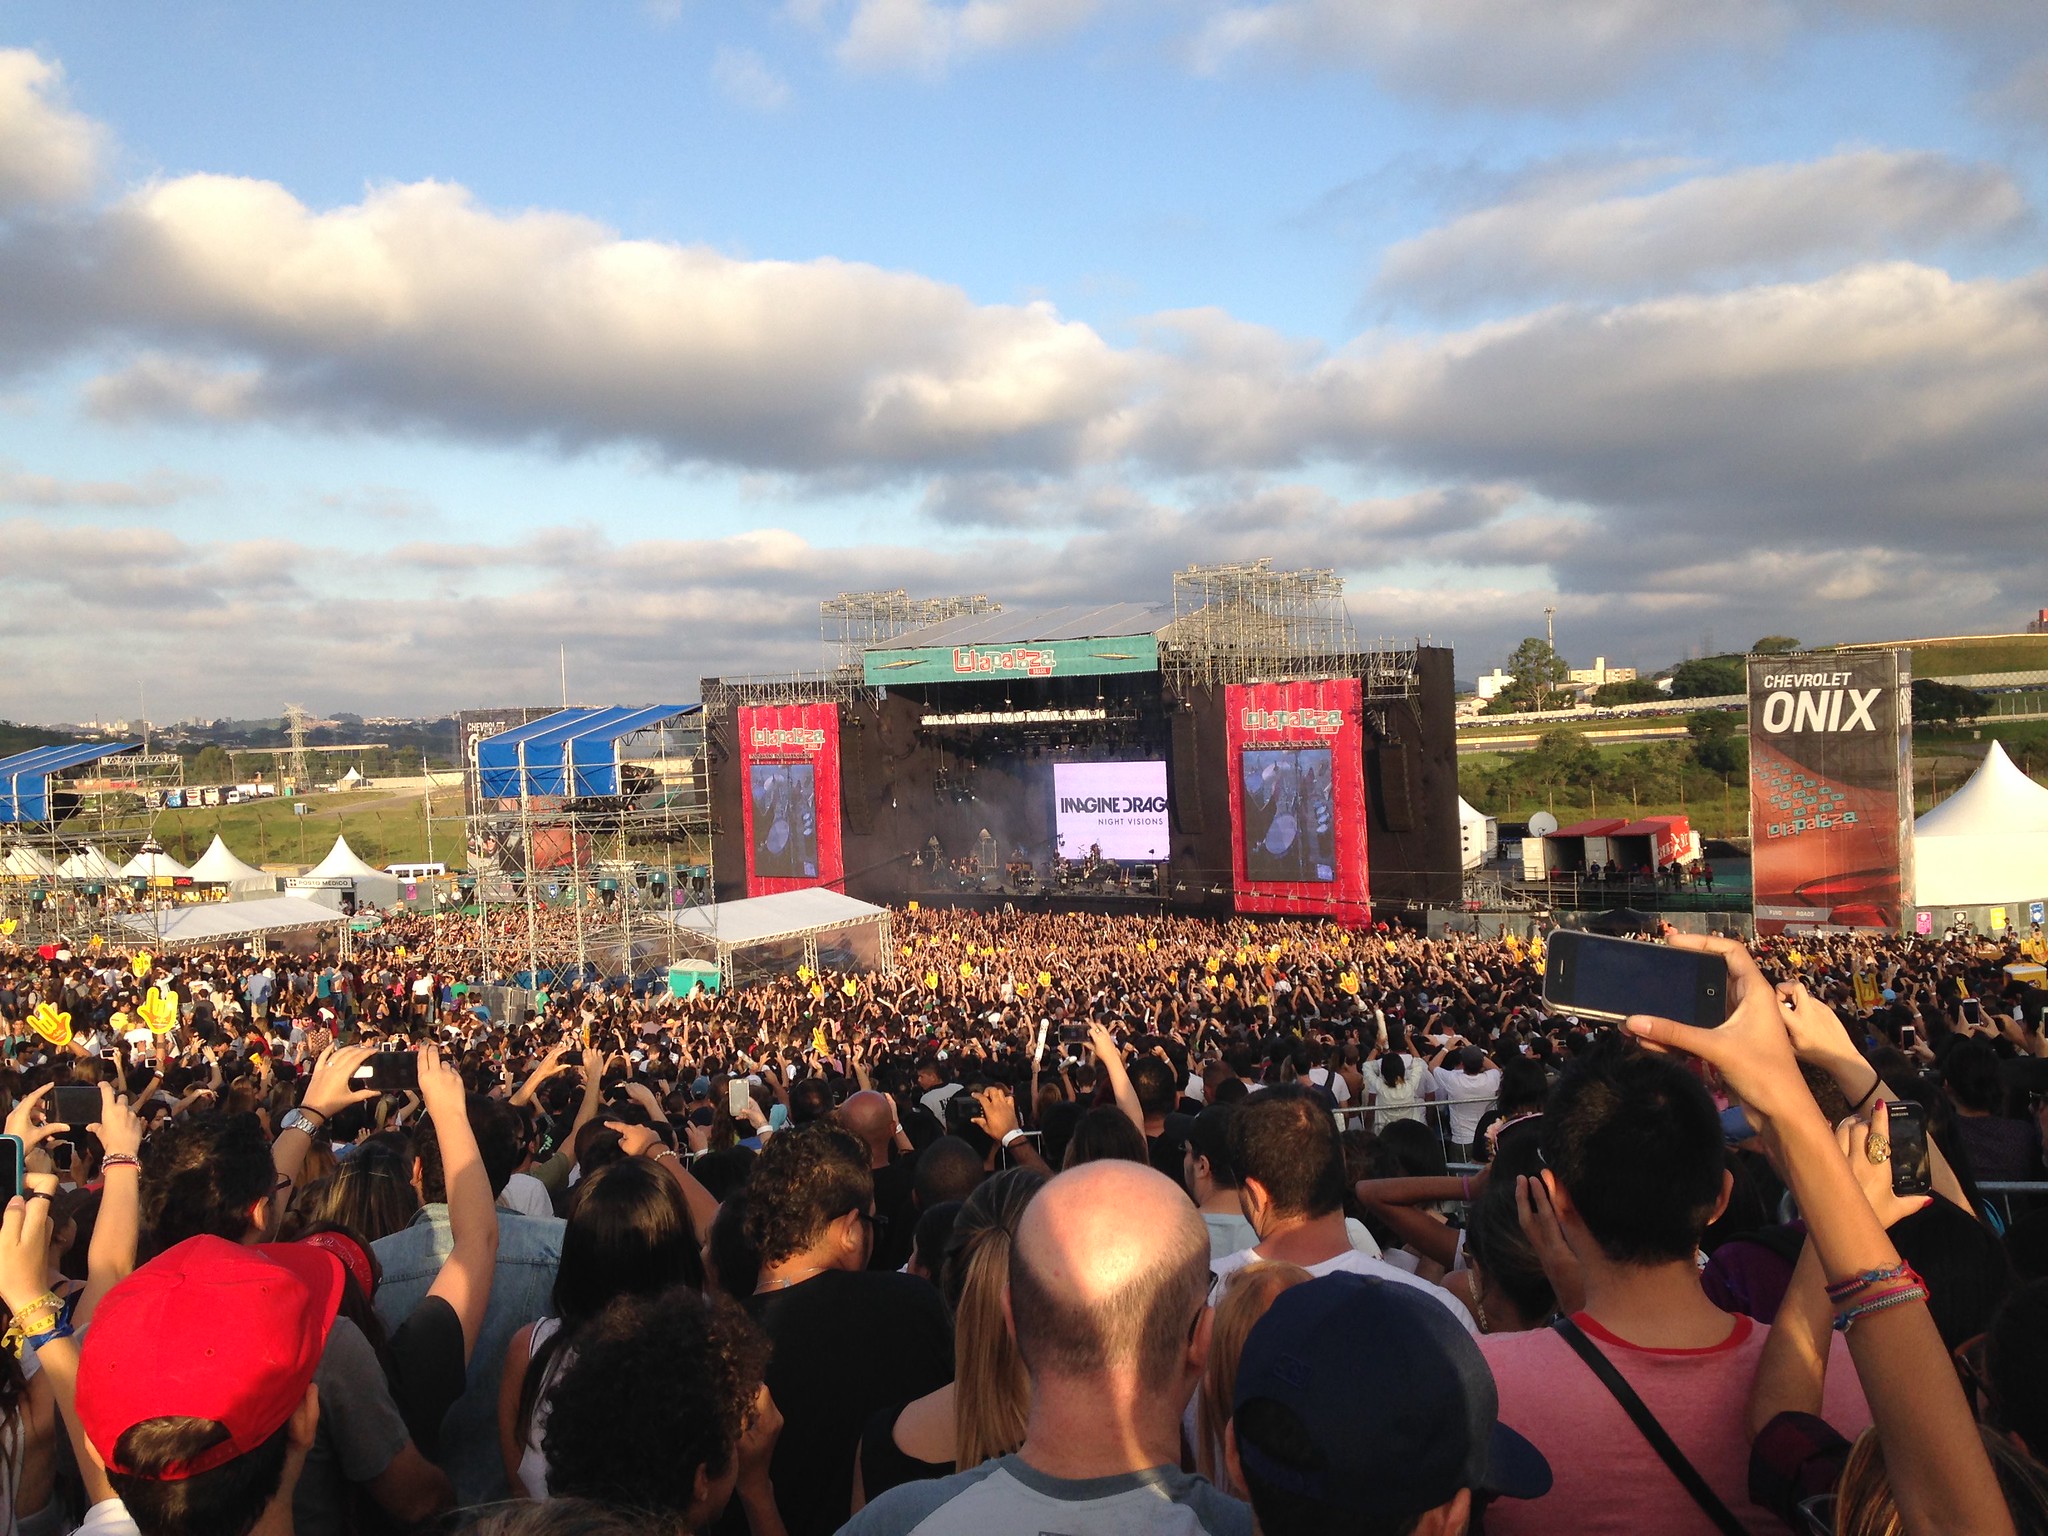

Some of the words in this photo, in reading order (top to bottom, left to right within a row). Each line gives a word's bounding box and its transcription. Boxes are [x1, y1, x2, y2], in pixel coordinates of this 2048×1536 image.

[1764, 672, 1852, 688] CHEVROLET
[1762, 688, 1882, 734] ONIX
[1061, 797, 1120, 814] IMAGINE
[1122, 796, 1168, 813] DRAG
[1098, 818, 1124, 826] NIGHT
[1127, 817, 1164, 826] VISIONS
